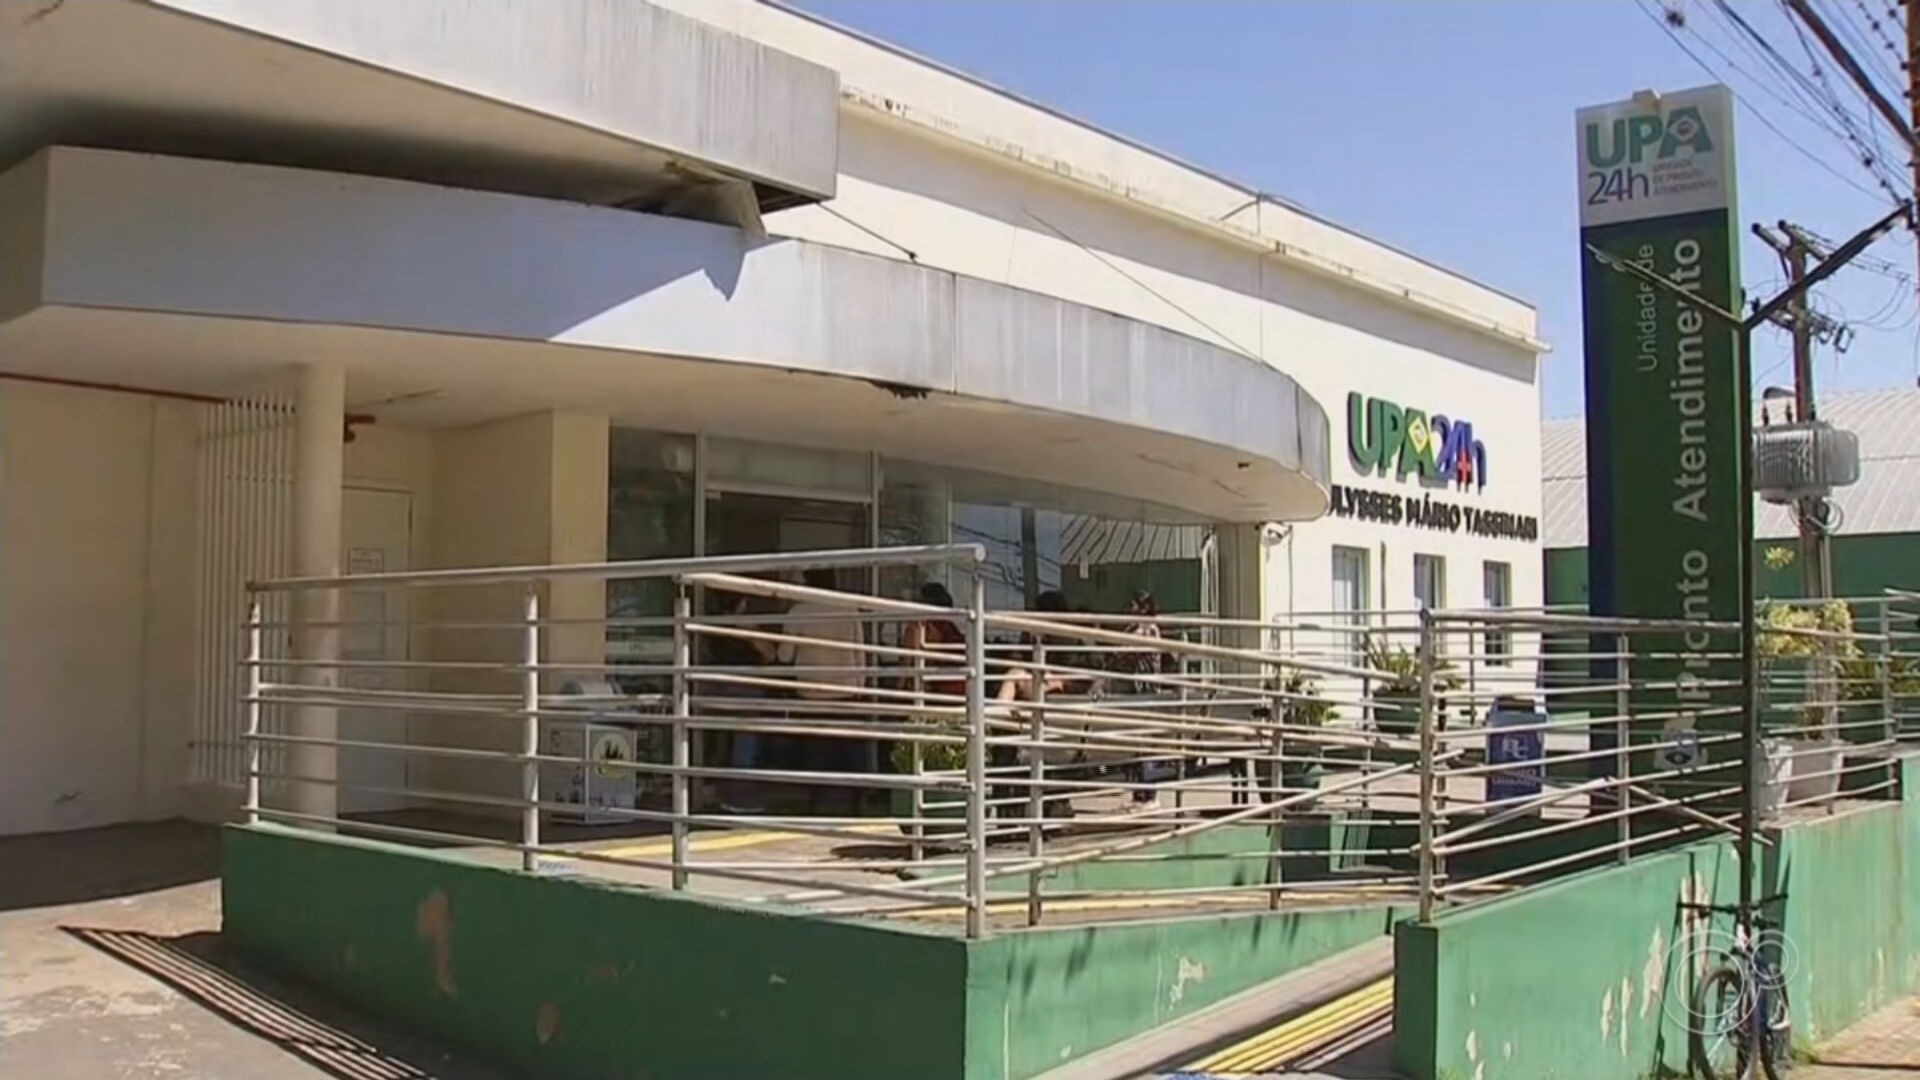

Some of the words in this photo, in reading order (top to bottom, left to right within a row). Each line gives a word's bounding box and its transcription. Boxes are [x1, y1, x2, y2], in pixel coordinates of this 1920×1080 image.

[1585, 106, 1713, 168] UPA
[1587, 166, 1650, 206] 24h
[1637, 281, 1658, 372] Unidade
[1669, 239, 1709, 522] Atendimento
[1406, 492, 1461, 534] MÁRIO
